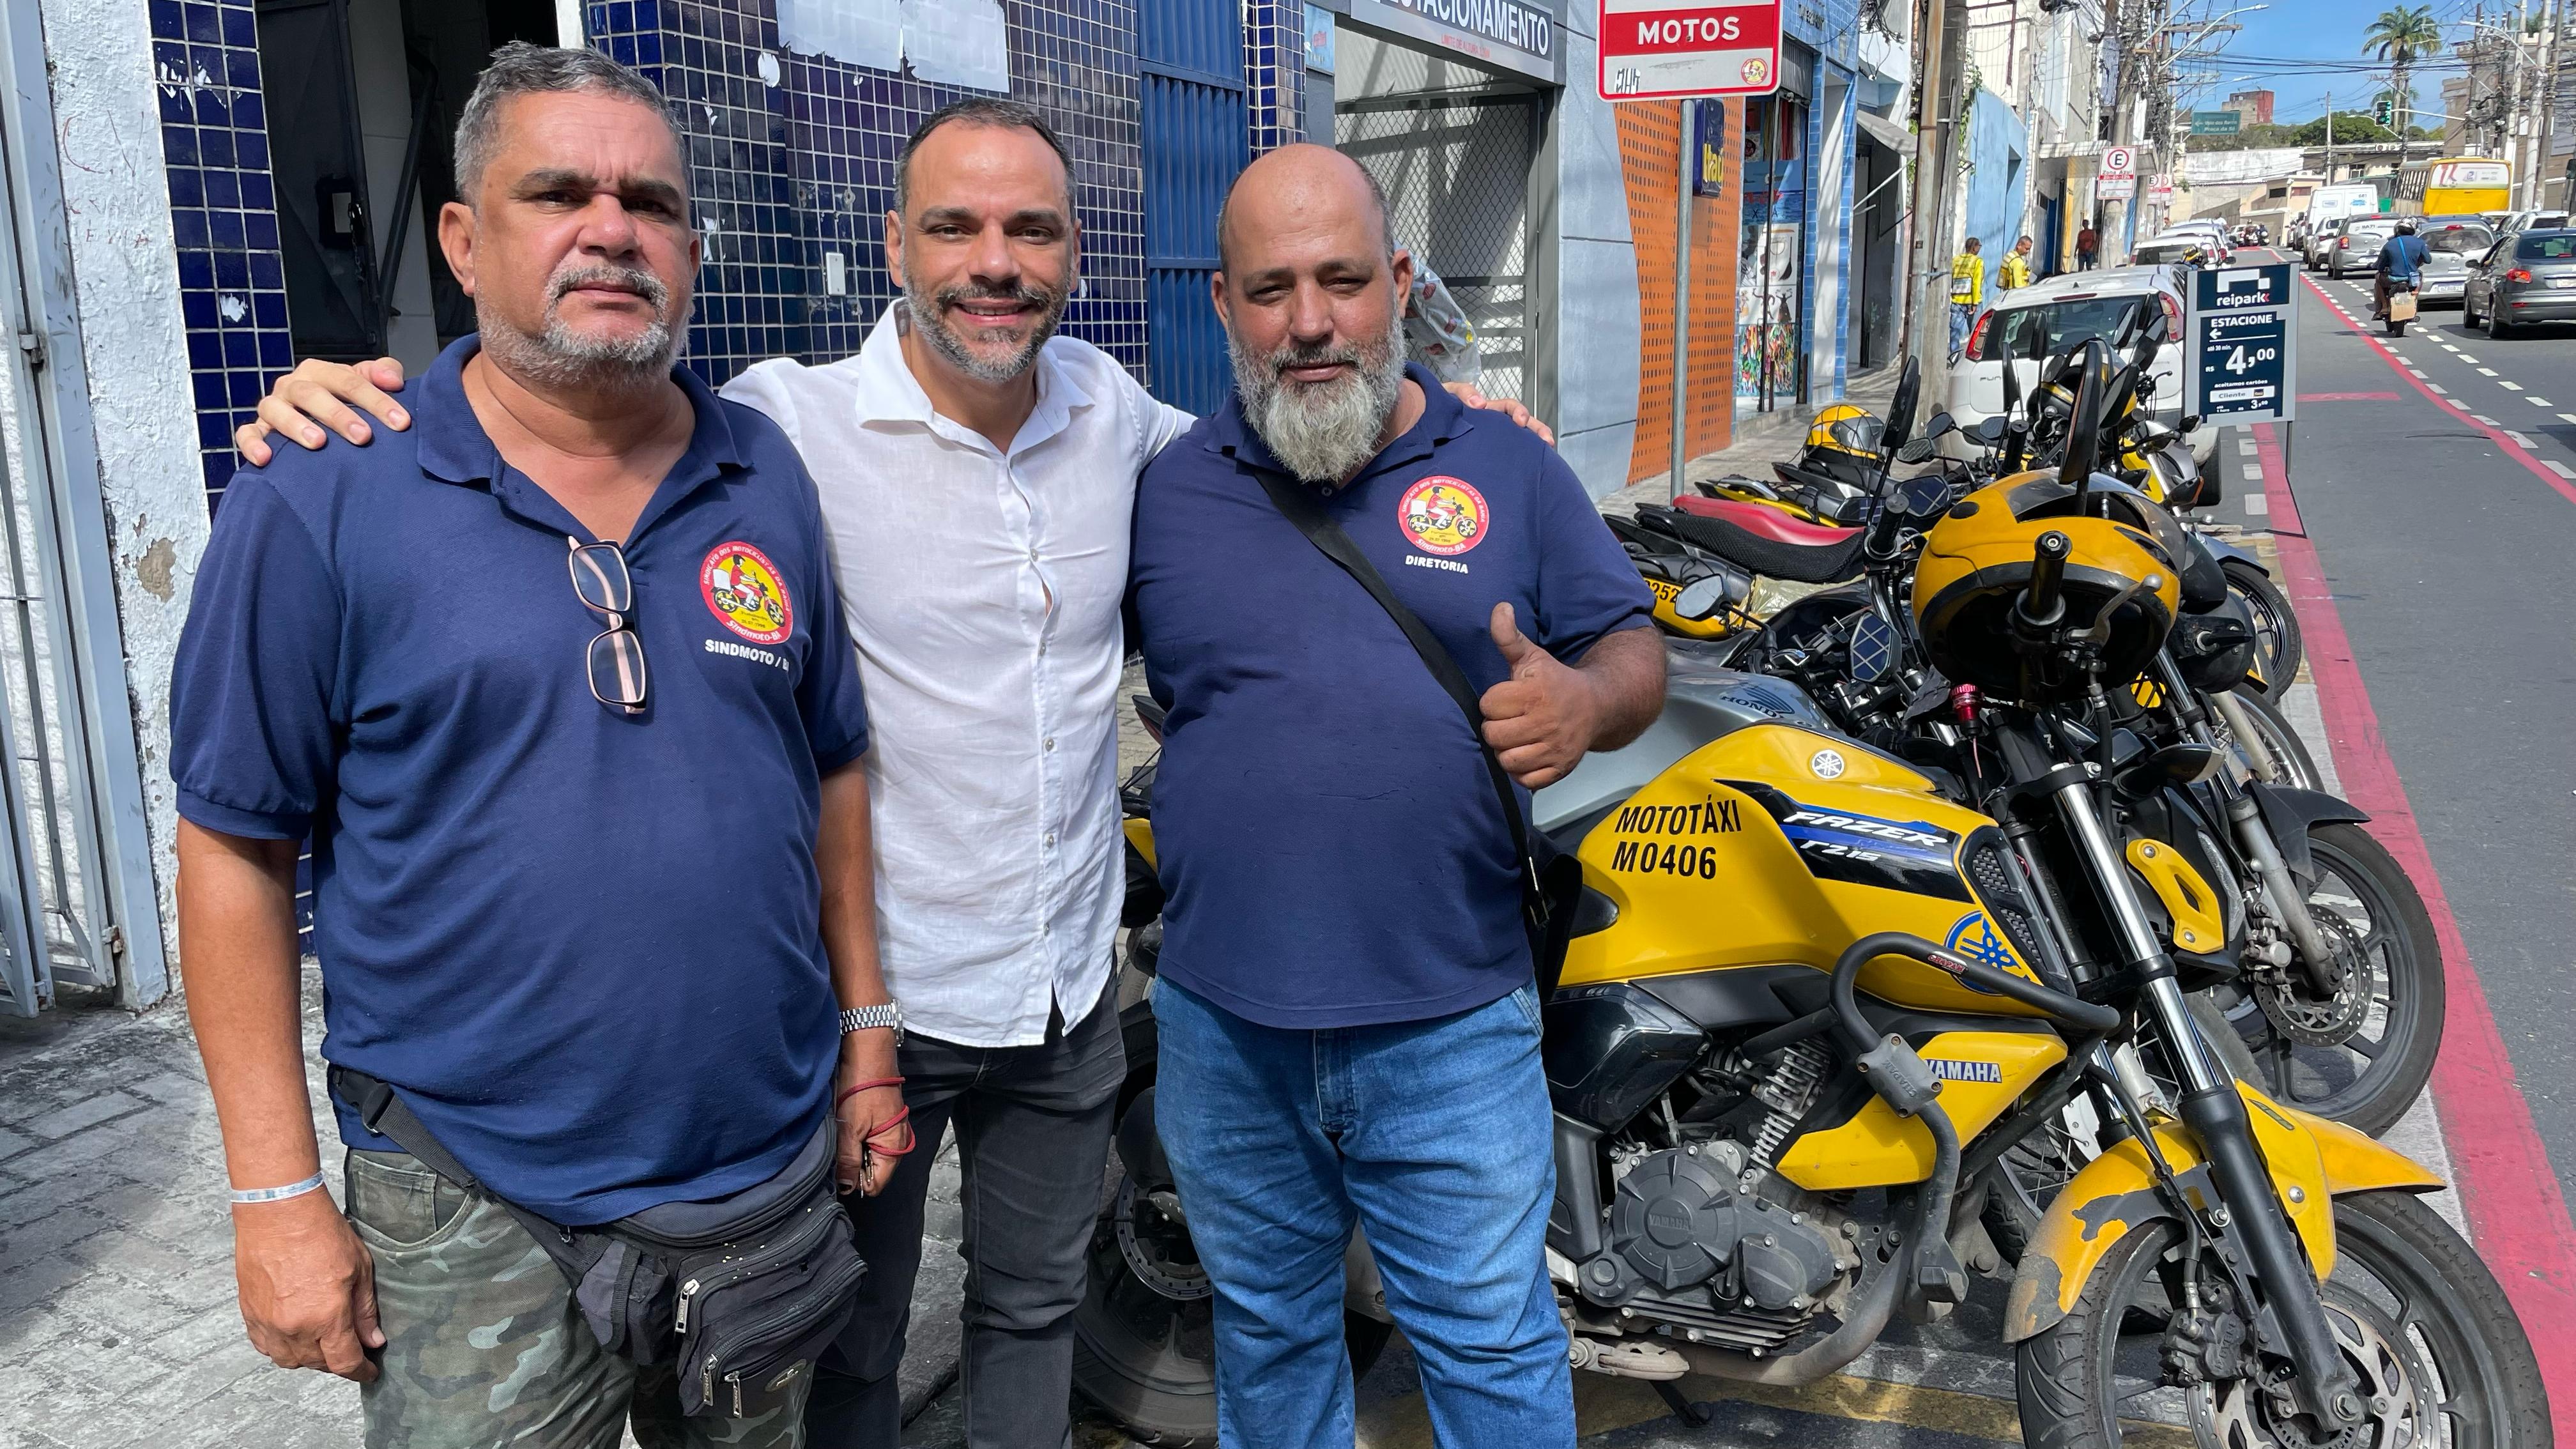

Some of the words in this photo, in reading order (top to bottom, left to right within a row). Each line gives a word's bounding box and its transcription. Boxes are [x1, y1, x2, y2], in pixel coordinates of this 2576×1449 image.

[1389, 0, 1549, 56] CIONAMENTO
[1637, 16, 1740, 45] MOTOS
[2115, 153, 2123, 165] E
[2211, 314, 2273, 328] ESTACIONE
[2226, 345, 2275, 374] 4,00
[704, 554, 719, 585] SINDICATO
[719, 548, 731, 556] DOS
[732, 546, 776, 575] MOTOCICLISTAS
[774, 576, 783, 586] DA
[1406, 555, 1468, 574] DIRETORIA
[1645, 580, 1679, 602] 252
[726, 620, 783, 641] Sindmoto-BA
[705, 639, 774, 665] SINDMOTO
[1719, 696, 1784, 718] HOND
[1614, 794, 1742, 835] MOTOTÁXI
[1783, 811, 1948, 847] FAZER
[1611, 841, 1717, 880] M0406
[1924, 1059, 2002, 1082] YAMAHA
[1648, 1213, 1690, 1231] YAMAHA
